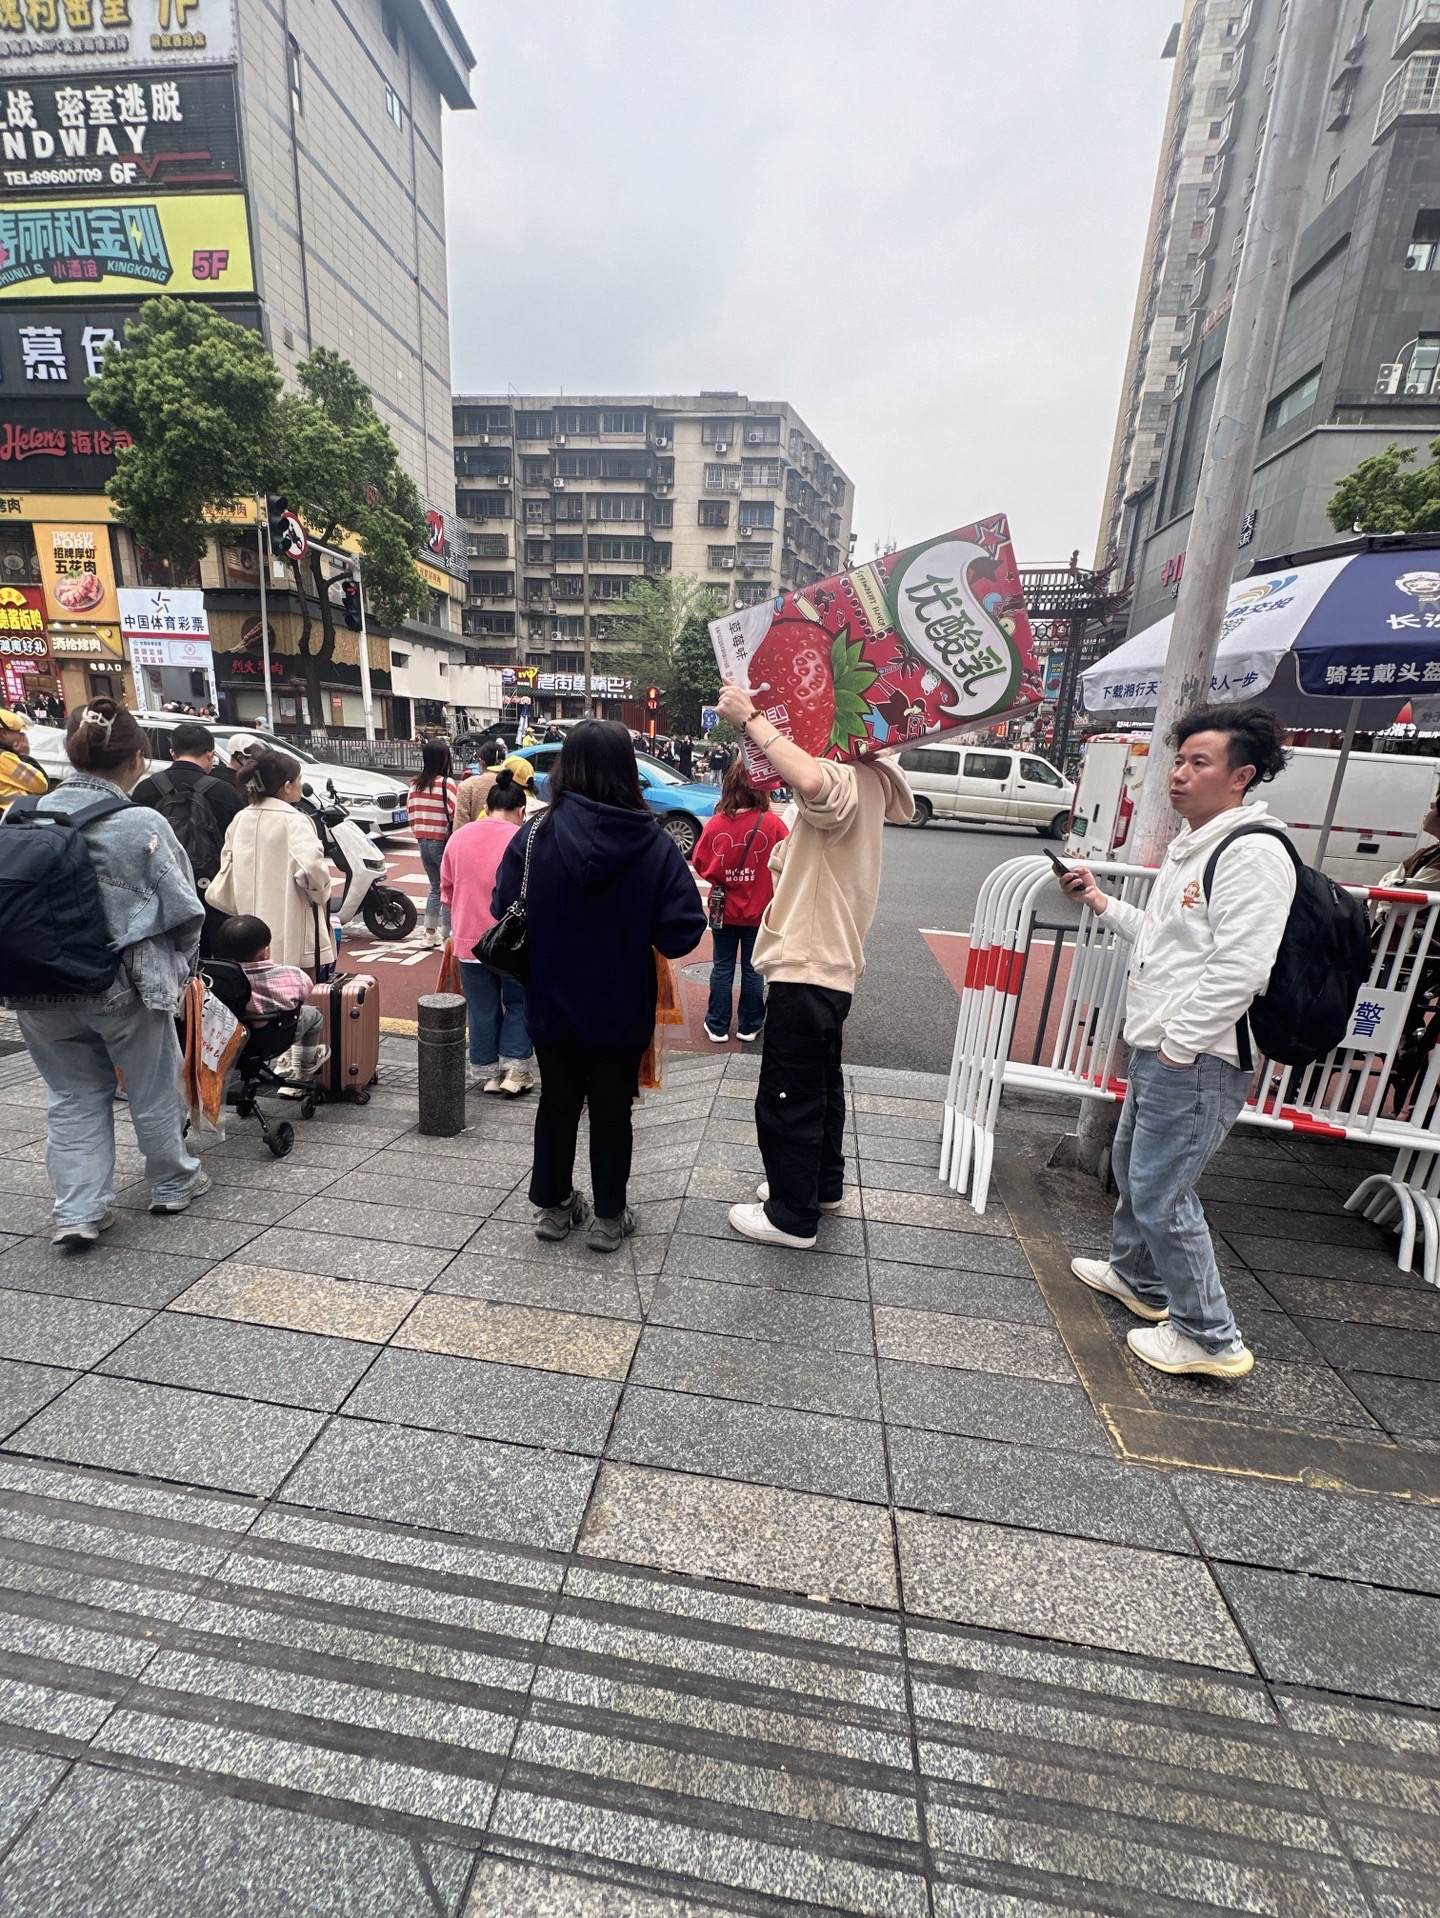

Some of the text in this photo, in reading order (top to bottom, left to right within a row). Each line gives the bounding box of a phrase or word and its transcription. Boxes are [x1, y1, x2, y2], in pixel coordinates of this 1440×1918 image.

[54, 81, 183, 128] 密室逃脱
[4, 162, 137, 186] TEL:89600709 6F
[53, 259, 98, 279] 小酒馆
[107, 260, 167, 283] KINGKONG
[192, 250, 229, 280] 5F
[0, 423, 66, 460] Helen's
[53, 538, 95, 549] PORK
[53, 547, 96, 559] 招牌厚切
[55, 560, 97, 575] 五花肉
[124, 614, 205, 632] 中国体育彩票
[904, 573, 1008, 697] 优酸乳
[1325, 662, 1440, 685] 骑车戴头盔
[1103, 681, 1163, 699] 下载湘行天
[725, 875, 755, 883] MOUSE
[1352, 1001, 1385, 1037] 警
